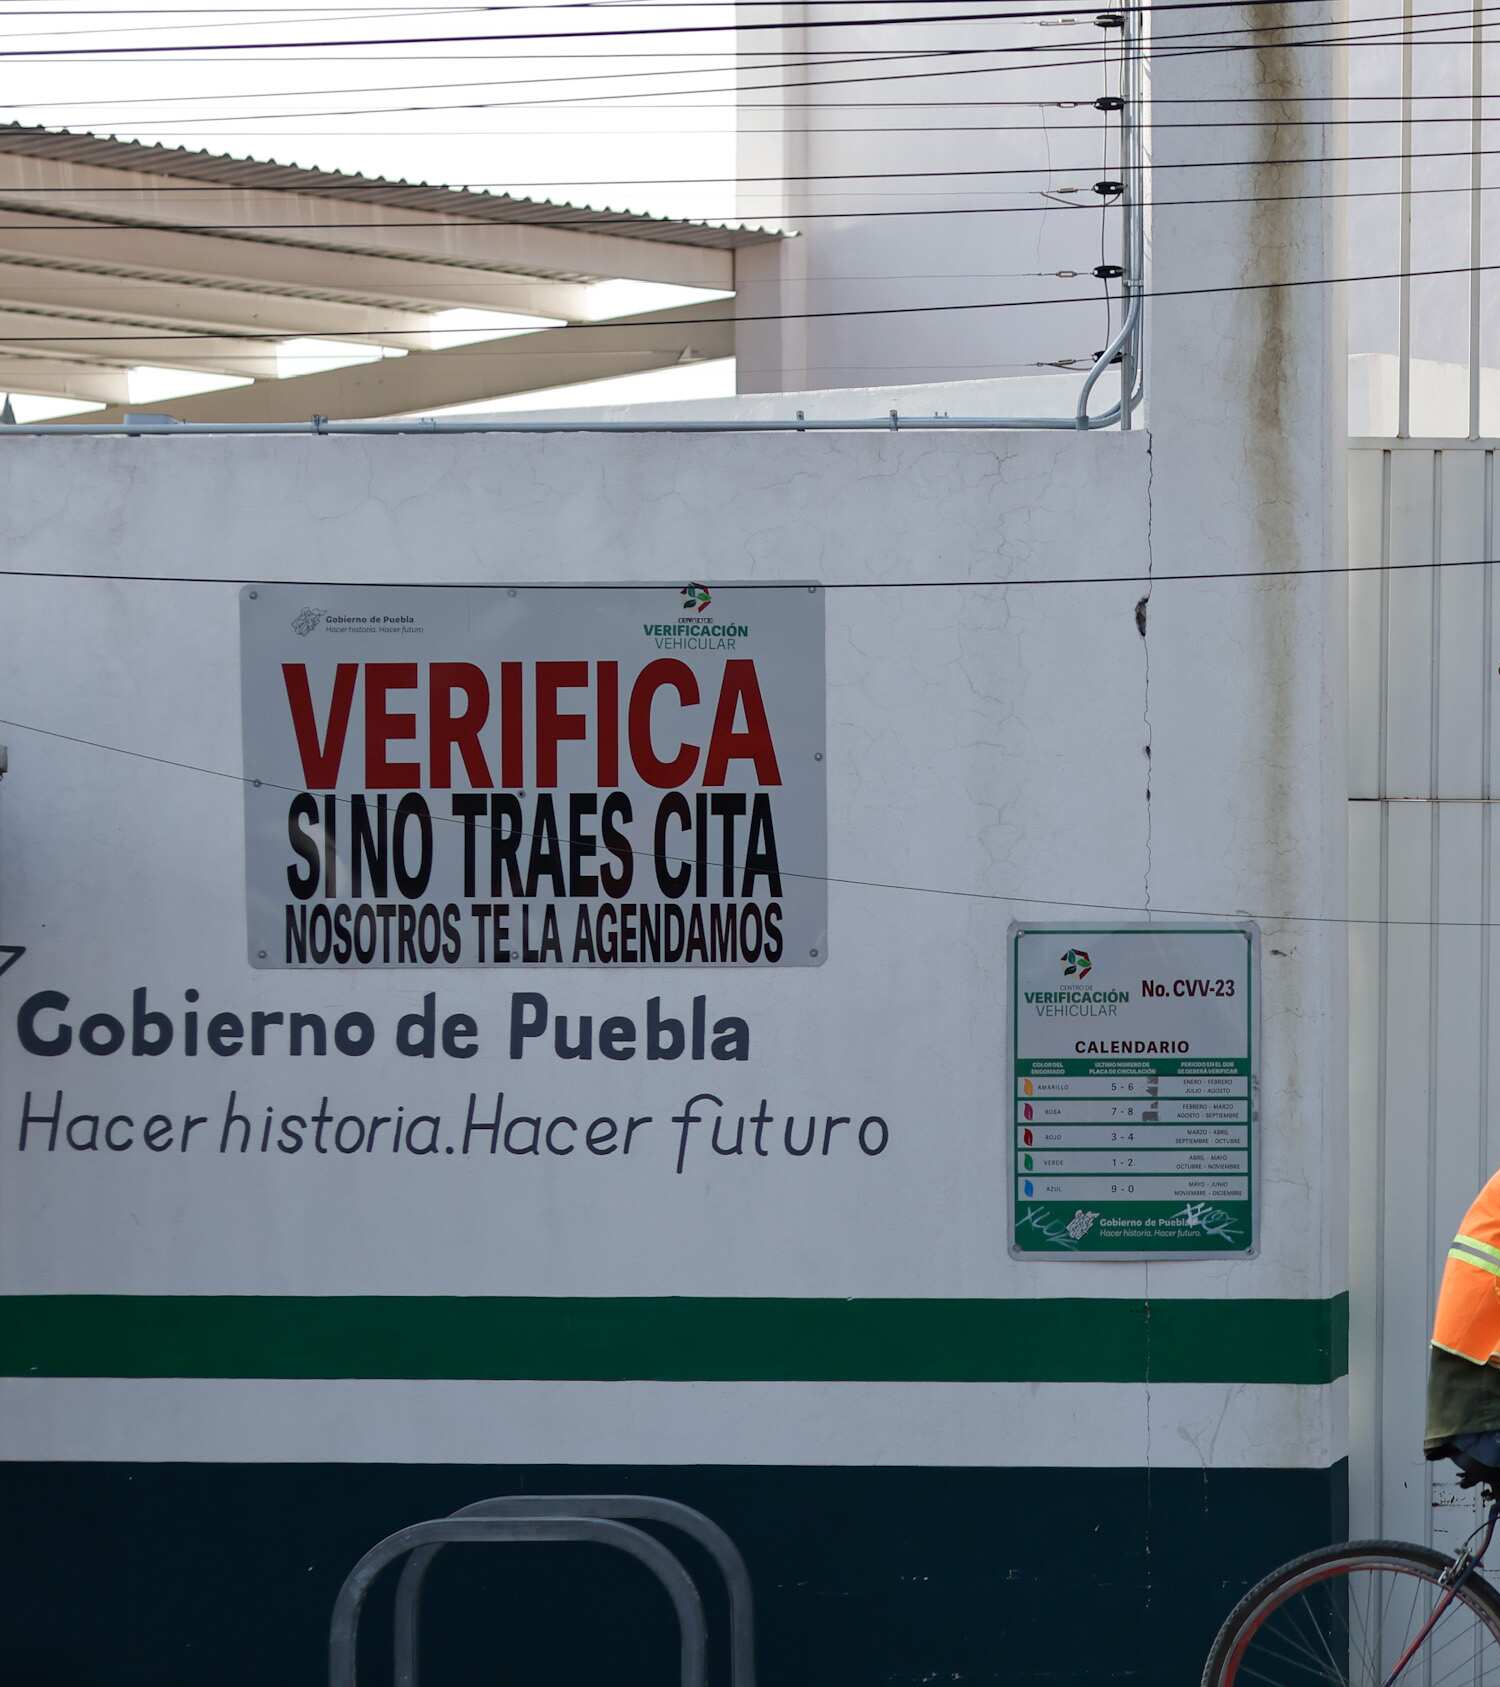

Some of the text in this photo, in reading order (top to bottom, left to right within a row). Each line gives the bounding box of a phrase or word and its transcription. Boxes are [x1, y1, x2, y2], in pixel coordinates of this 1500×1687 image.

[326, 616, 415, 624] Gobierno de Puebla
[643, 623, 748, 637] VERIFICACIÓN
[655, 638, 736, 650] VEHICULAR
[281, 658, 783, 789] VERIFICA
[287, 791, 783, 899] SI NO TRAES CITA
[286, 902, 783, 964] NOSOTROS TE LA AGENDAMOS
[1142, 980, 1235, 997] No. CVV-23
[1025, 989, 1129, 1003] VERIFICACIÓN
[1036, 1005, 1117, 1017] VEHICULAR
[16, 987, 751, 1062] Gobierno de Puebla
[1075, 1041, 1190, 1054] CALENDARIO
[1111, 1083, 1117, 1091] 5
[1128, 1083, 1134, 1091] 6
[18, 1090, 208, 1154] Hacer
[672, 1092, 890, 1175] futuro
[1111, 1133, 1117, 1141] 3
[1128, 1133, 1134, 1141] 4
[1128, 1159, 1134, 1167] 2
[1111, 1185, 1117, 1193] 9
[1128, 1185, 1134, 1193] 0
[1100, 1218, 1190, 1226] Gobierno de Puebl
